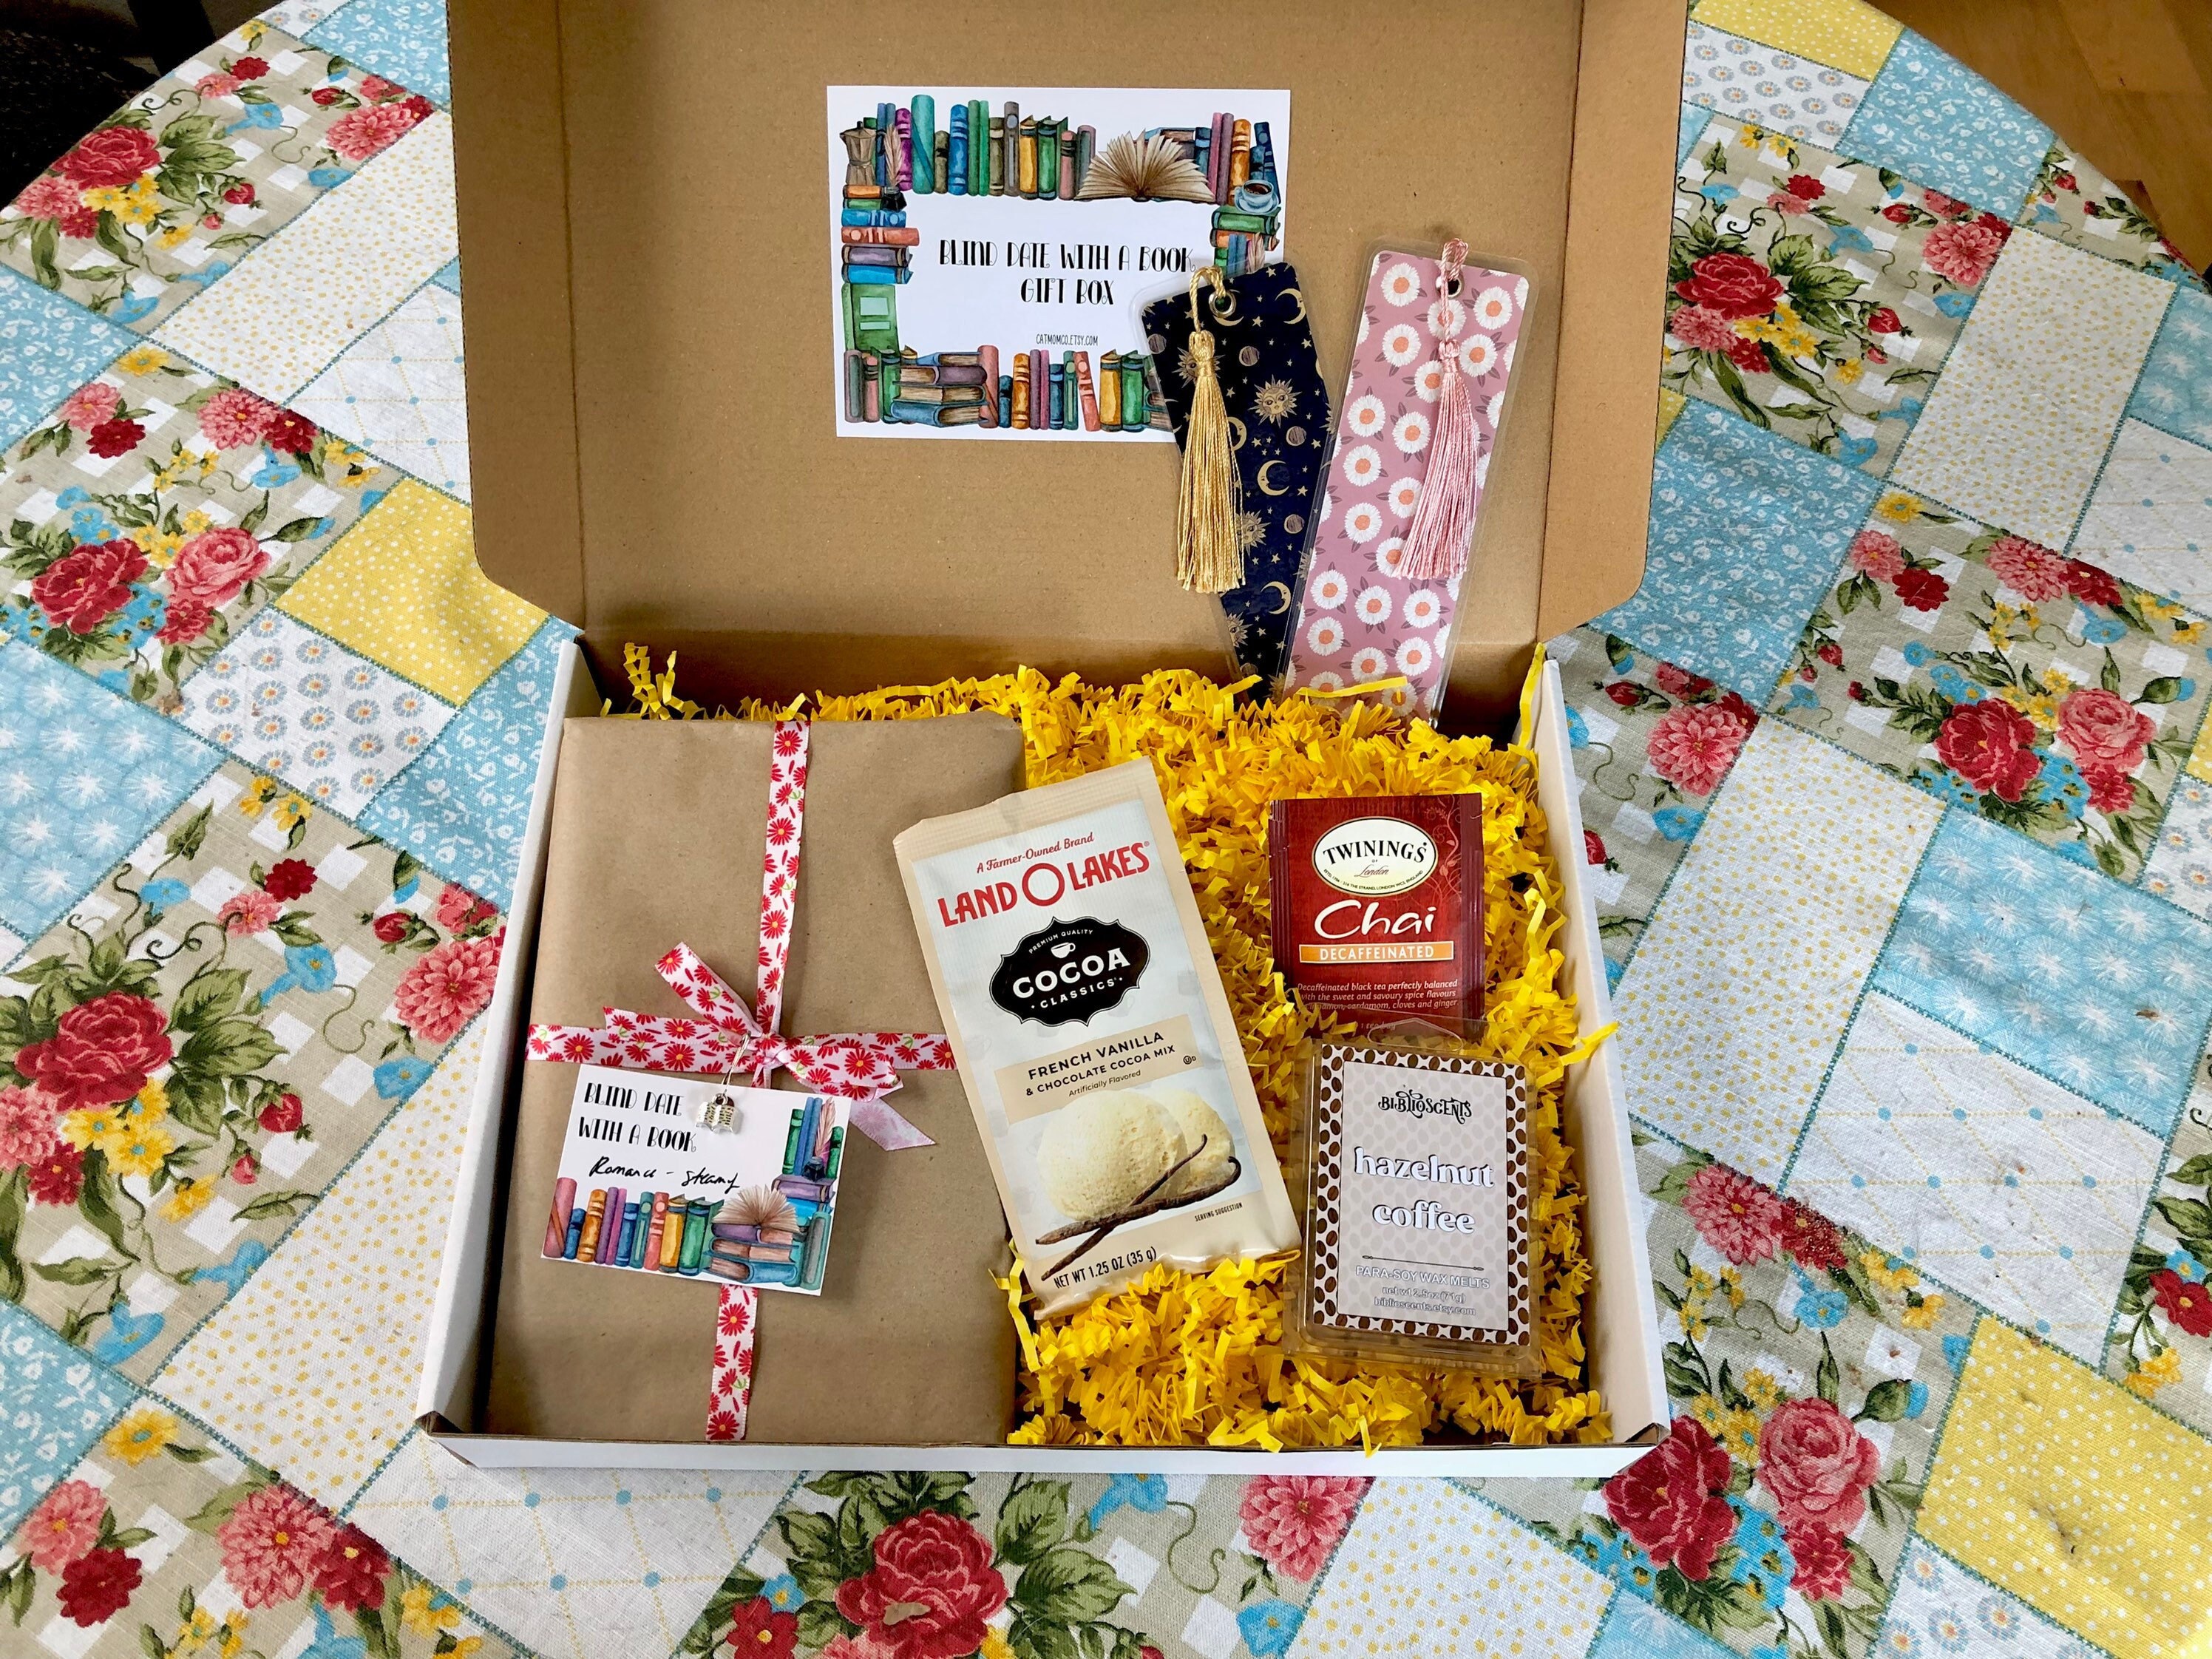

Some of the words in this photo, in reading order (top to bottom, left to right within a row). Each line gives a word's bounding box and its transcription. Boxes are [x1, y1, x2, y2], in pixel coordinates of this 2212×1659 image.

[940, 240, 997, 266] BLIND
[1007, 242, 1050, 268] DATE
[1060, 243, 1109, 270] WITH
[1119, 245, 1130, 271] A
[1139, 246, 1196, 272] BOOK
[1020, 278, 1066, 303] GIFT
[1076, 279, 1114, 305] BOX
[1036, 333, 1099, 346] CATMOMCO.ETSY.COM
[977, 862, 985, 874] A
[985, 841, 1061, 872] Farmer-Owned
[1064, 832, 1095, 849] Brand
[1323, 840, 1427, 865] TWININGS
[1354, 864, 1390, 878] London
[937, 881, 1018, 927] LAND
[1022, 863, 1065, 906] O
[1314, 899, 1436, 939] Chai
[1028, 934, 1059, 954] PREMIUM
[1061, 929, 1093, 937] QUALITY
[1320, 945, 1434, 960] DECAFFEINATED
[1012, 947, 1131, 999] COCOA
[1297, 983, 1348, 991] Decaffeinated
[1351, 983, 1371, 991] black
[1388, 982, 1422, 992] perfectly
[1424, 979, 1458, 989] balanced
[1039, 978, 1115, 1008] CLASSICS
[1357, 992, 1371, 1000] and
[1373, 993, 1402, 1002] savoury
[1405, 991, 1424, 1001] spice
[1427, 990, 1456, 998] flavours
[1393, 1000, 1415, 1009] cloves
[1417, 1000, 1432, 1008] and
[1434, 1000, 1459, 1009] ginger.
[1028, 1052, 1092, 1080] FRENCH
[1096, 1031, 1164, 1058] VANILLA
[1026, 1088, 1034, 1096] &
[1037, 1065, 1107, 1093] CHOCOLATE
[1110, 1053, 1151, 1071] COCOA
[1153, 1045, 1175, 1058] MIX
[1068, 1079, 1107, 1097] Artificially
[1109, 1069, 1141, 1085] Flavored
[584, 1082, 637, 1109] BLIND
[644, 1091, 684, 1116] DATE
[1378, 1089, 1472, 1124] BIBLIOSCENTS
[578, 1116, 622, 1142] WITH
[628, 1124, 641, 1145] A
[647, 1126, 696, 1153] BOOK
[1354, 1146, 1495, 1187] hazelnut
[1195, 1210, 1214, 1222] SERVING
[1215, 1202, 1243, 1215] SUGGESTION
[1372, 1199, 1475, 1234] coffee
[1054, 1273, 1070, 1289] NET
[1072, 1268, 1086, 1283] WT
[1088, 1261, 1110, 1278] 1.25
[1111, 1256, 1124, 1270] OZ
[1127, 1249, 1144, 1267] (35
[1146, 1246, 1157, 1263] g)
[1356, 1266, 1419, 1282] PARA-SOY
[1419, 1272, 1447, 1285] WAX
[1450, 1275, 1490, 1289] MELTS
[1374, 1297, 1476, 1316] biblioscents.etsy.com
[1382, 1286, 1398, 1295] net
[1399, 1288, 1412, 1296] wt
[1413, 1288, 1440, 1299] 2.5oz
[1441, 1291, 1466, 1304] (71g)
